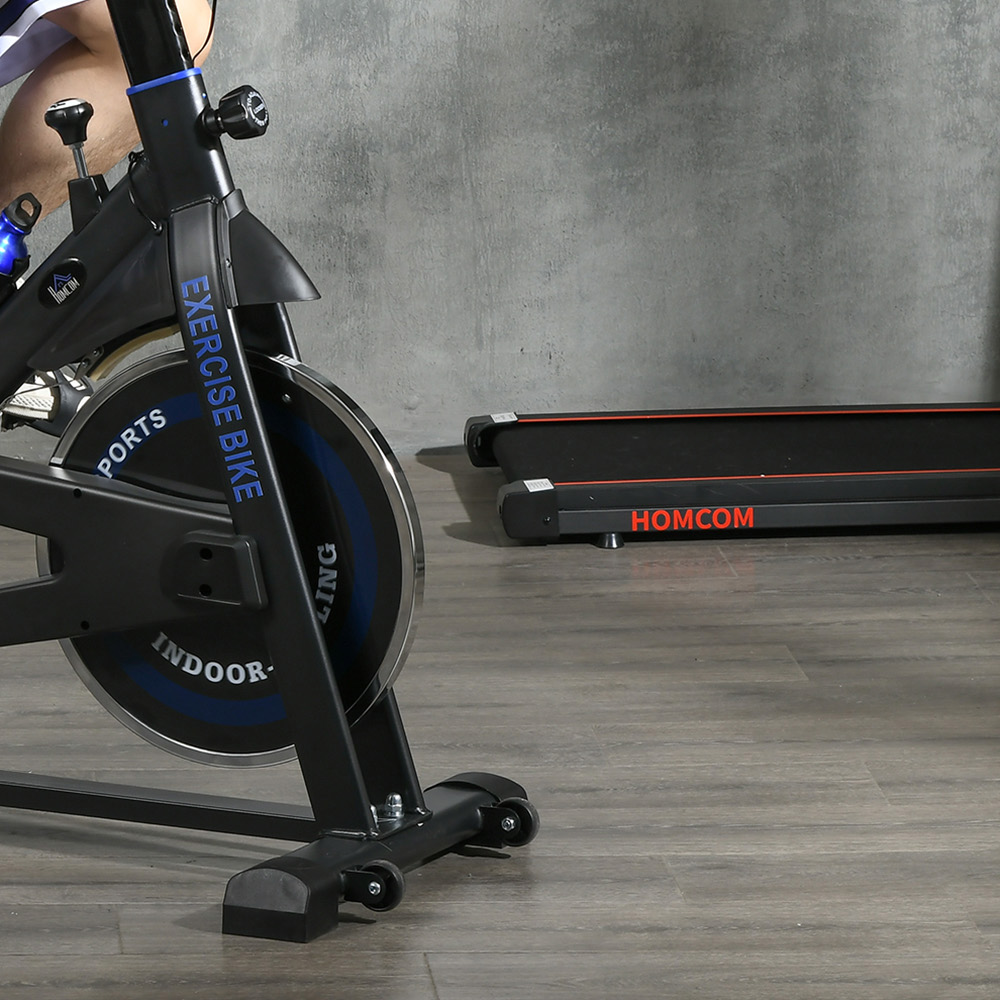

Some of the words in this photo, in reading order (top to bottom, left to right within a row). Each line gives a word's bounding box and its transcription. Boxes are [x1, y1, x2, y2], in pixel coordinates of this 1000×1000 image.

[180, 275, 243, 427] EXERCISE
[218, 429, 263, 503] BIKE
[631, 506, 755, 532] HOMCOM
